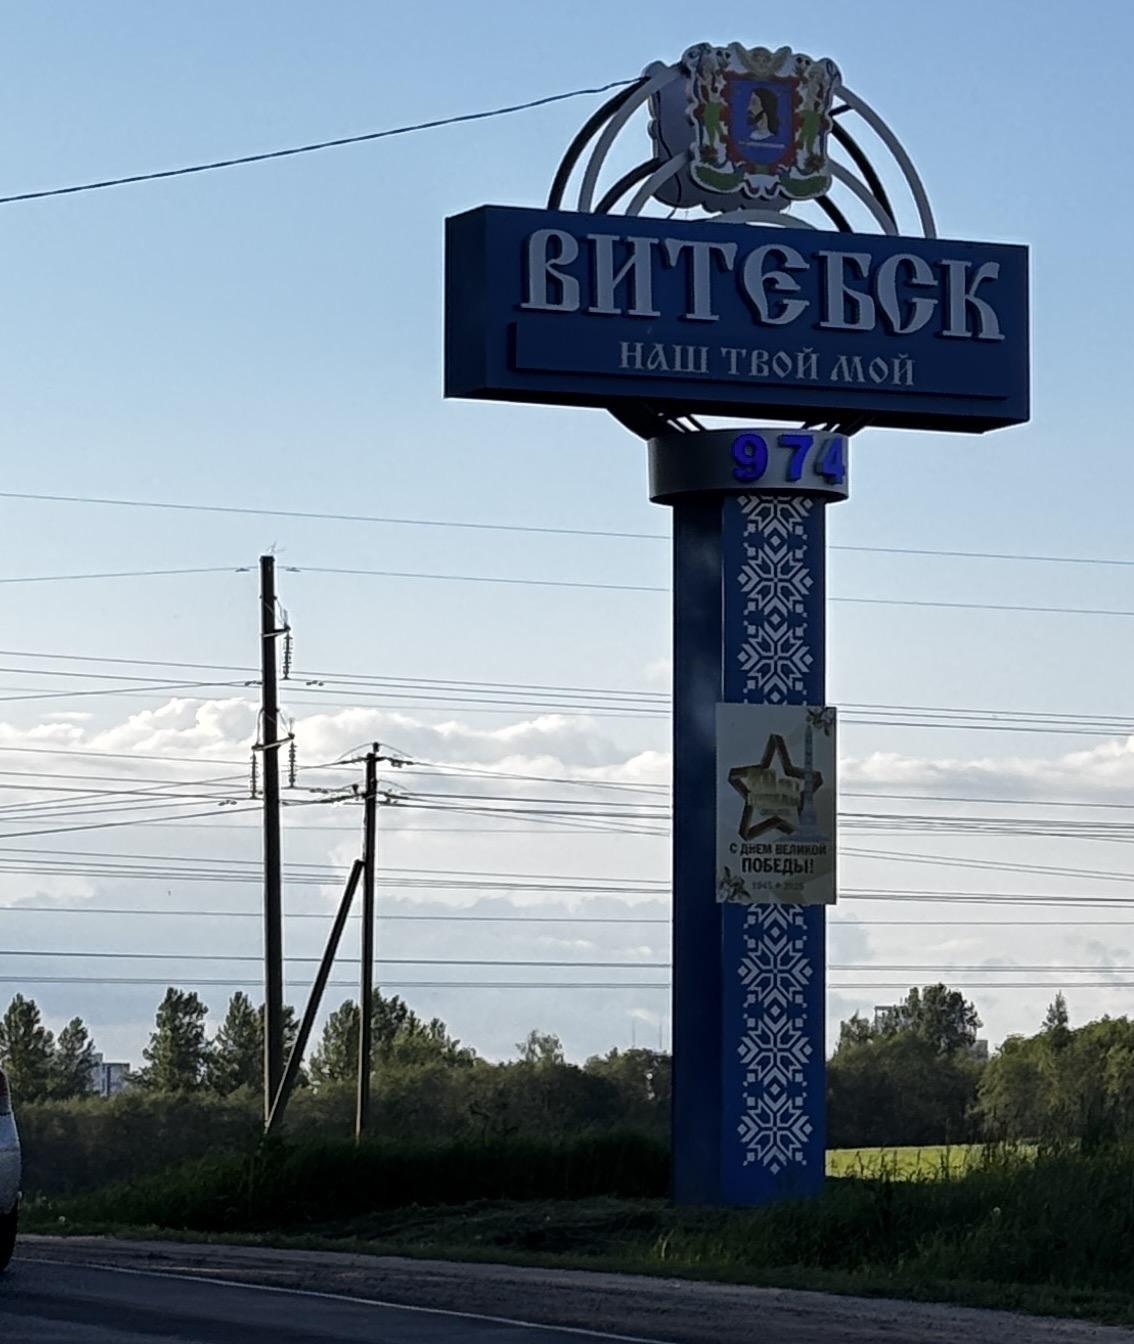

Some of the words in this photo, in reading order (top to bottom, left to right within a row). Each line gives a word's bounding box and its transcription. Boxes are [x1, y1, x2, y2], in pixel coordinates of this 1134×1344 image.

[520, 228, 1005, 340] ВИТЕБСК
[619, 341, 710, 374] НАШ
[720, 346, 819, 380] ТВОЙ
[830, 353, 916, 386] МОЙ
[731, 433, 846, 484] 974
[729, 843, 737, 853] С
[740, 844, 772, 855] ДНЕМ
[775, 843, 827, 855] ВЕЛИКОЙ
[742, 857, 814, 876] ПОБЕДЫ!
